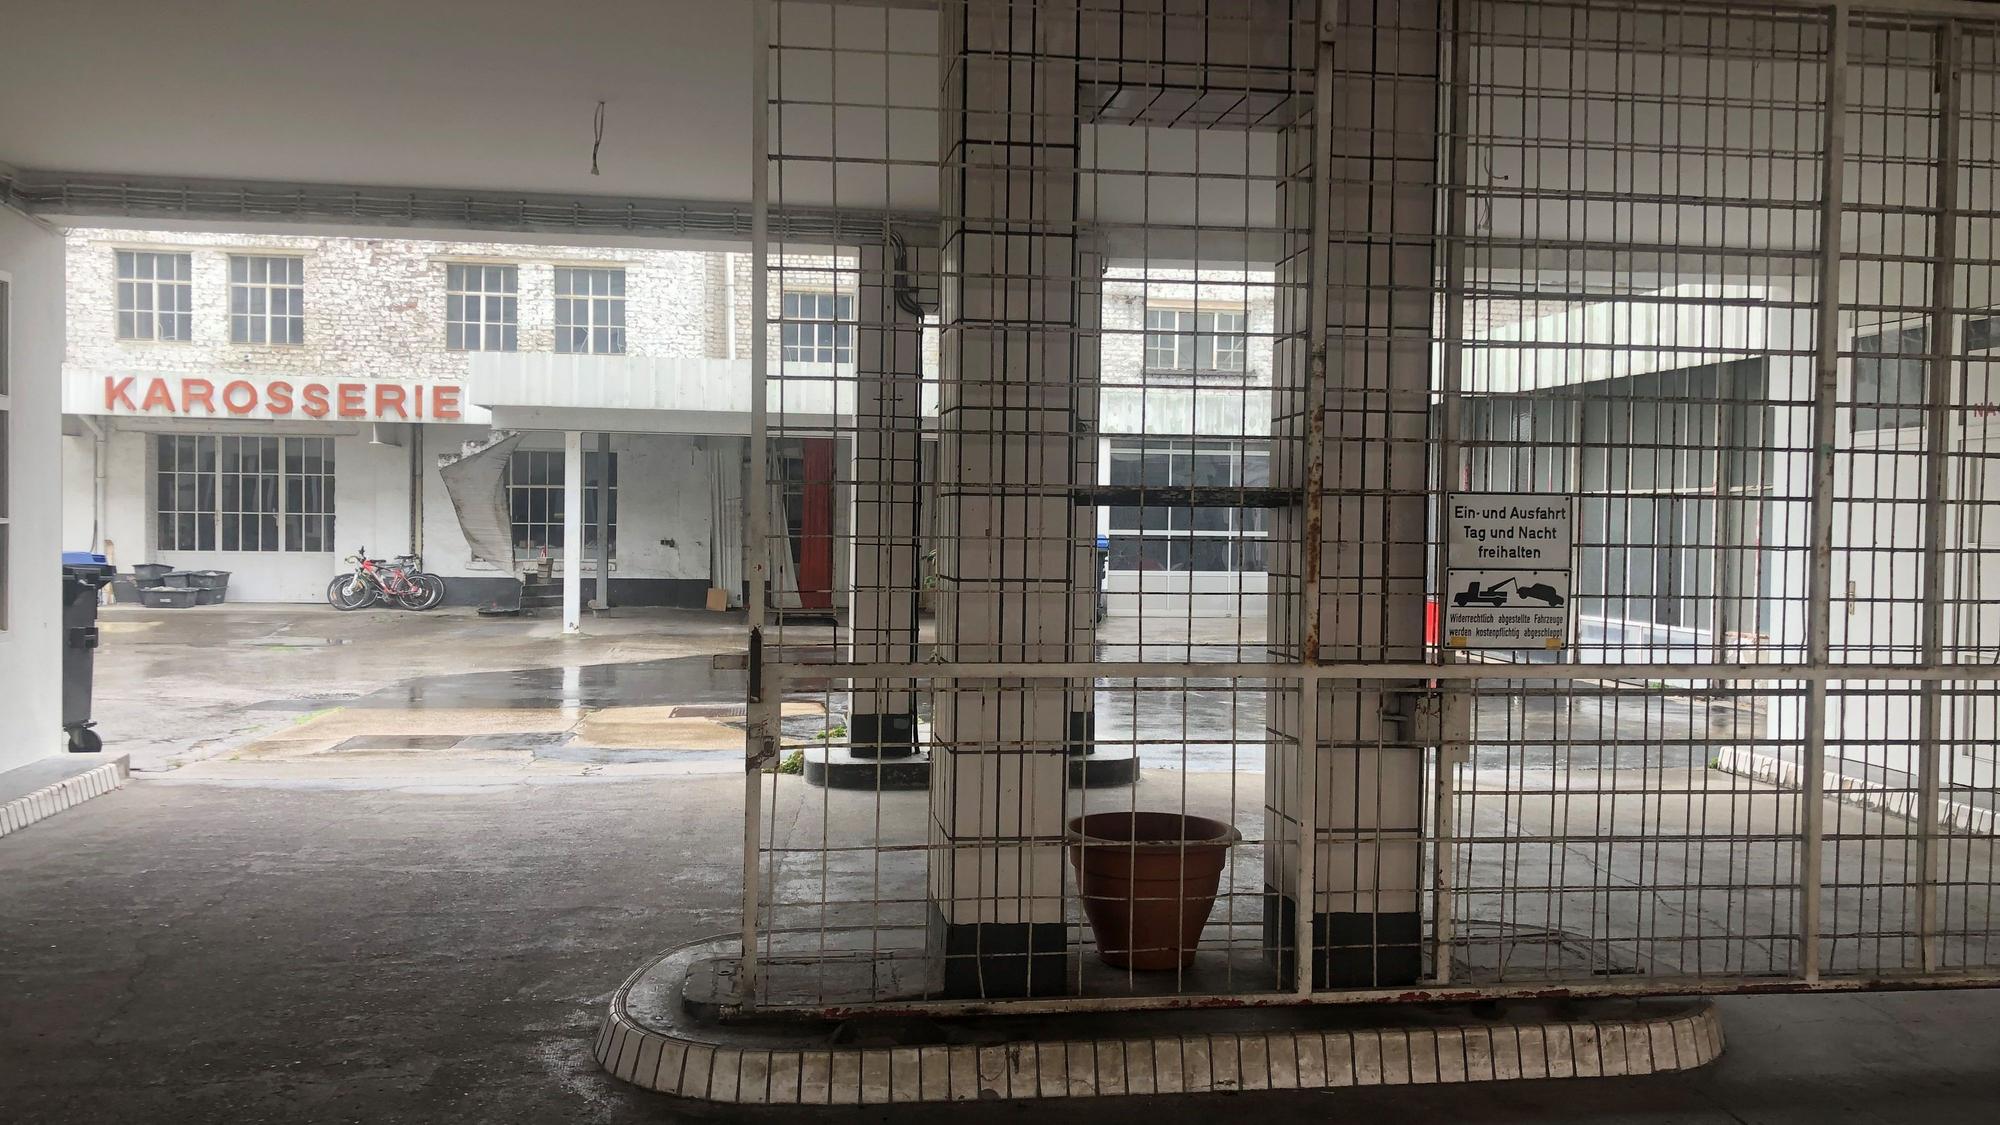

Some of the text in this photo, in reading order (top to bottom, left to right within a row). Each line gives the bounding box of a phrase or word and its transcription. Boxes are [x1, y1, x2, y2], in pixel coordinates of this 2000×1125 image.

[105, 376, 461, 419] KAROSSERIE
[1483, 506, 1506, 519] und
[1510, 506, 1566, 520] Ausfahrt
[1464, 526, 1557, 541] Tag und Nacht
[1478, 546, 1541, 558] freihalten
[1450, 613, 1563, 625] Widerrechtlich abgestellte Fahrzeuge
[1449, 627, 1563, 639] werden kostenpflichtig abgeschleppt
